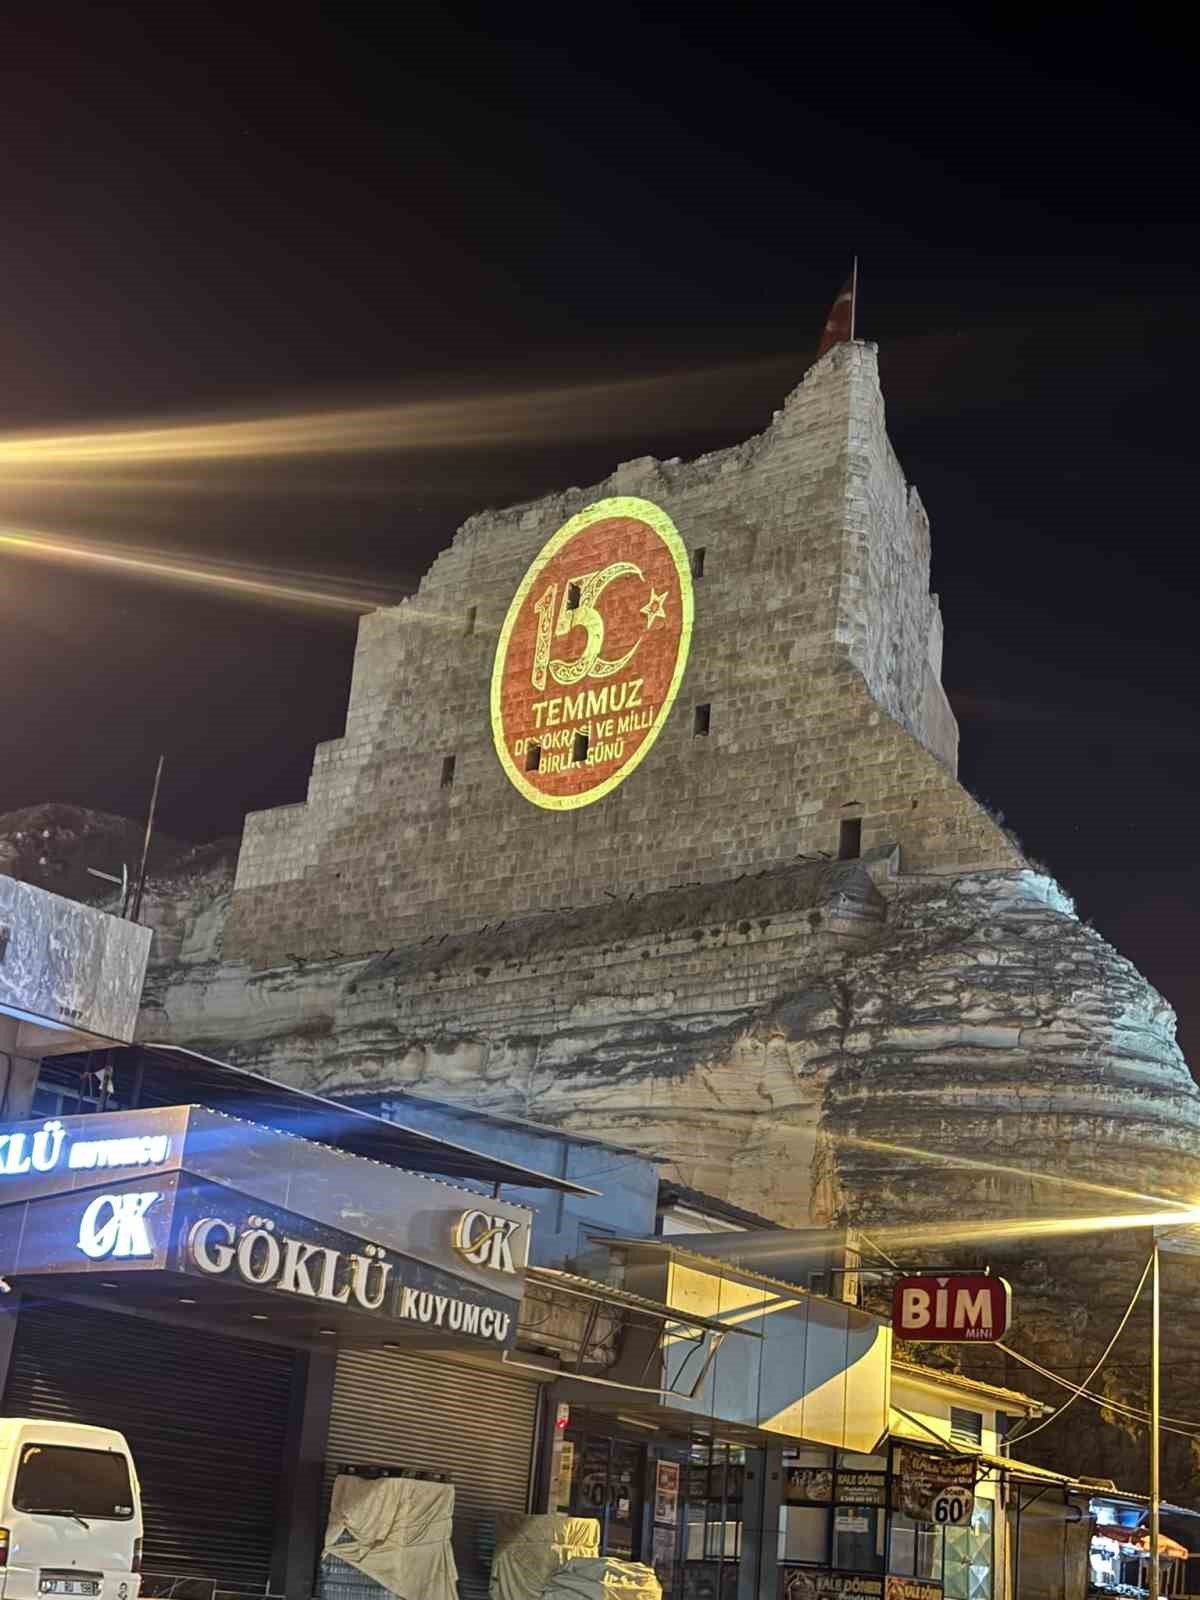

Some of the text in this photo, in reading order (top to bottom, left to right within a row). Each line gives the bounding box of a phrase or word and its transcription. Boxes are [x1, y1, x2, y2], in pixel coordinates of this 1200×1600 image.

[531, 569, 606, 691] 15
[531, 678, 644, 728] TEMMUZ
[596, 719, 614, 738] VE
[188, 1215, 511, 1341] GÖKLÜ KUYUMCU
[901, 1277, 993, 1329] BİM
[935, 1497, 963, 1523] 60
